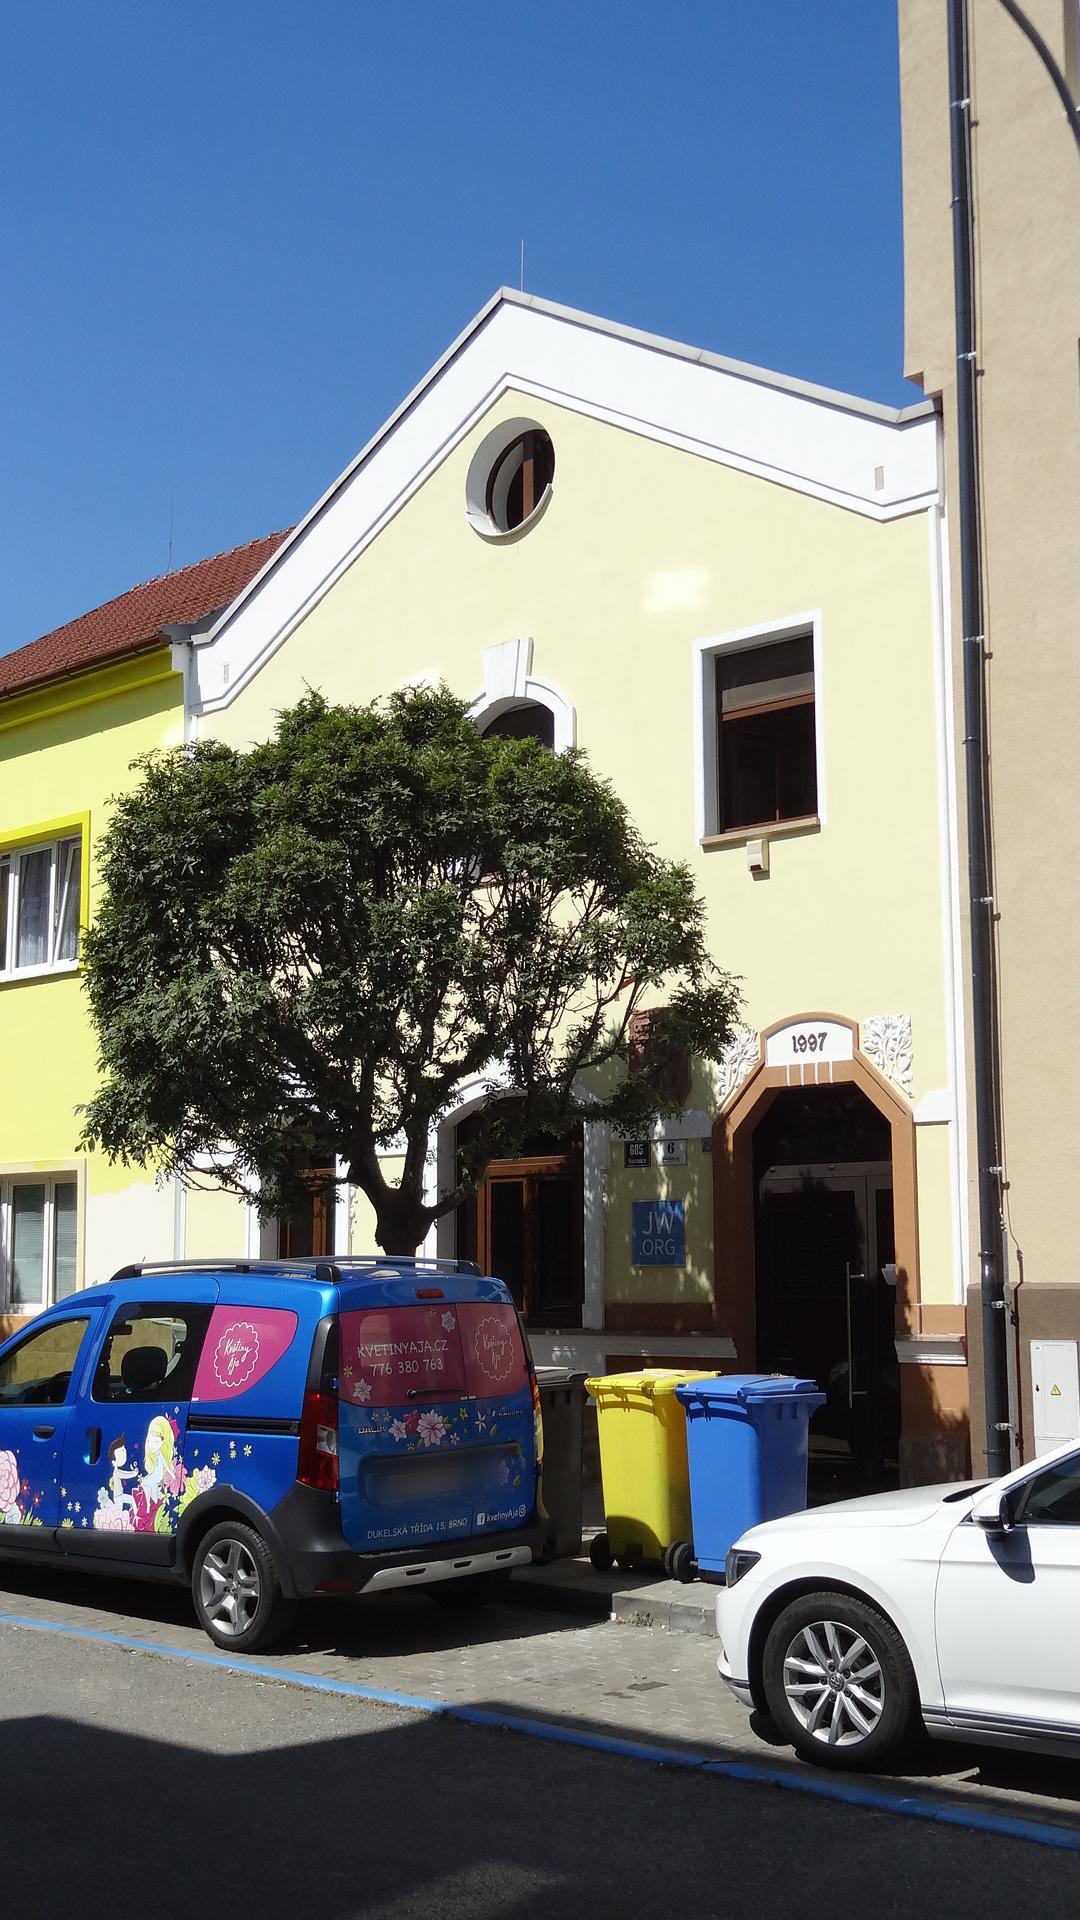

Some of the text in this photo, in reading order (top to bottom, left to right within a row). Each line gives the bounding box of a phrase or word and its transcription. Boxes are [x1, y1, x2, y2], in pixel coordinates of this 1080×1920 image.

[792, 1032, 828, 1053] 1997
[629, 1144, 644, 1156] 605
[667, 1142, 675, 1154] 6
[642, 1211, 675, 1235] JW
[640, 1238, 675, 1256] .ORG
[357, 1339, 449, 1358] KVETINYAJA.CZ
[370, 1358, 443, 1377] 776 380 763
[367, 1524, 408, 1539] DUKELSKÁ
[410, 1521, 434, 1534] TŘÍDA
[448, 1518, 468, 1529] BRNO
